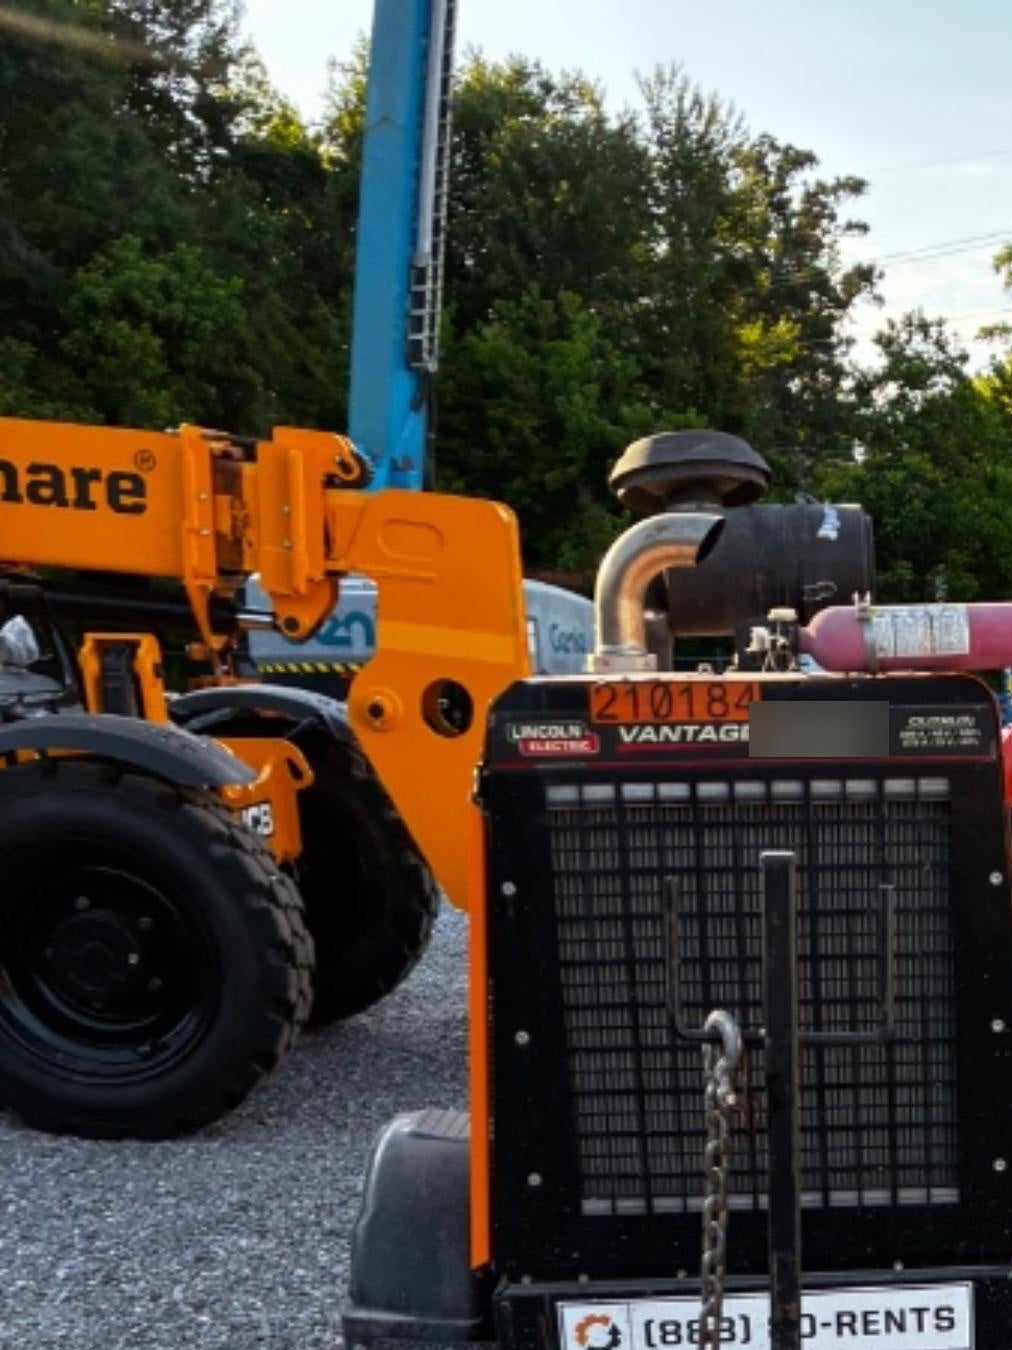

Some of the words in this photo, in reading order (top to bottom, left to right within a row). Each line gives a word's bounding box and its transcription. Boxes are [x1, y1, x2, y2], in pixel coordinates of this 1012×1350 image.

[593, 683, 753, 720] 210184
[511, 724, 582, 740] LINCOLN
[528, 739, 594, 752] ELECTRIC
